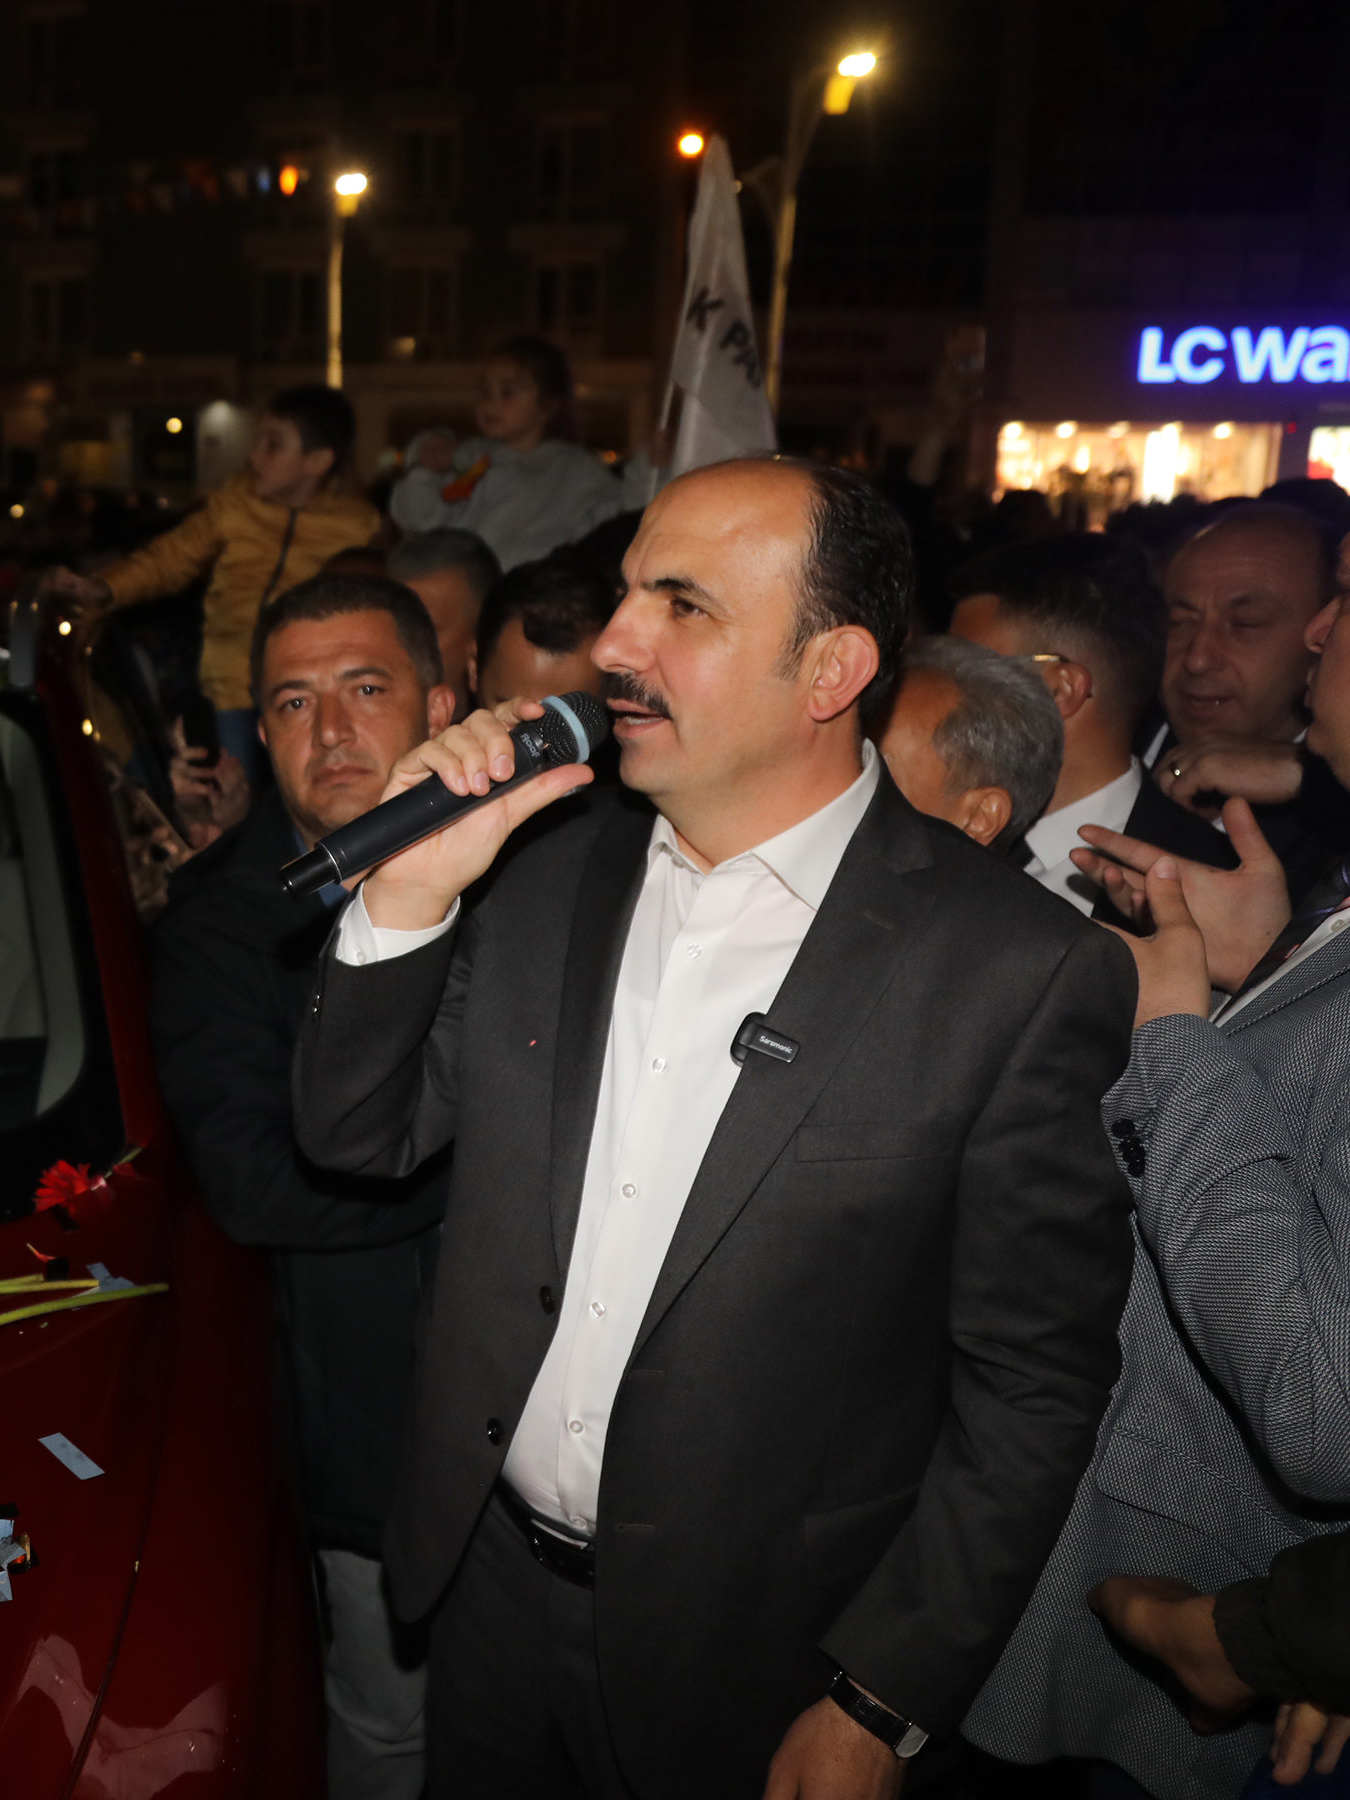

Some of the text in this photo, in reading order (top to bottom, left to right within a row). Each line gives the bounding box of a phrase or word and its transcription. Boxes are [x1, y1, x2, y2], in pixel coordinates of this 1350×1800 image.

[1136, 325, 1228, 385] LC
[520, 733, 541, 758] Roof
[759, 1035, 794, 1054] Saramonic
